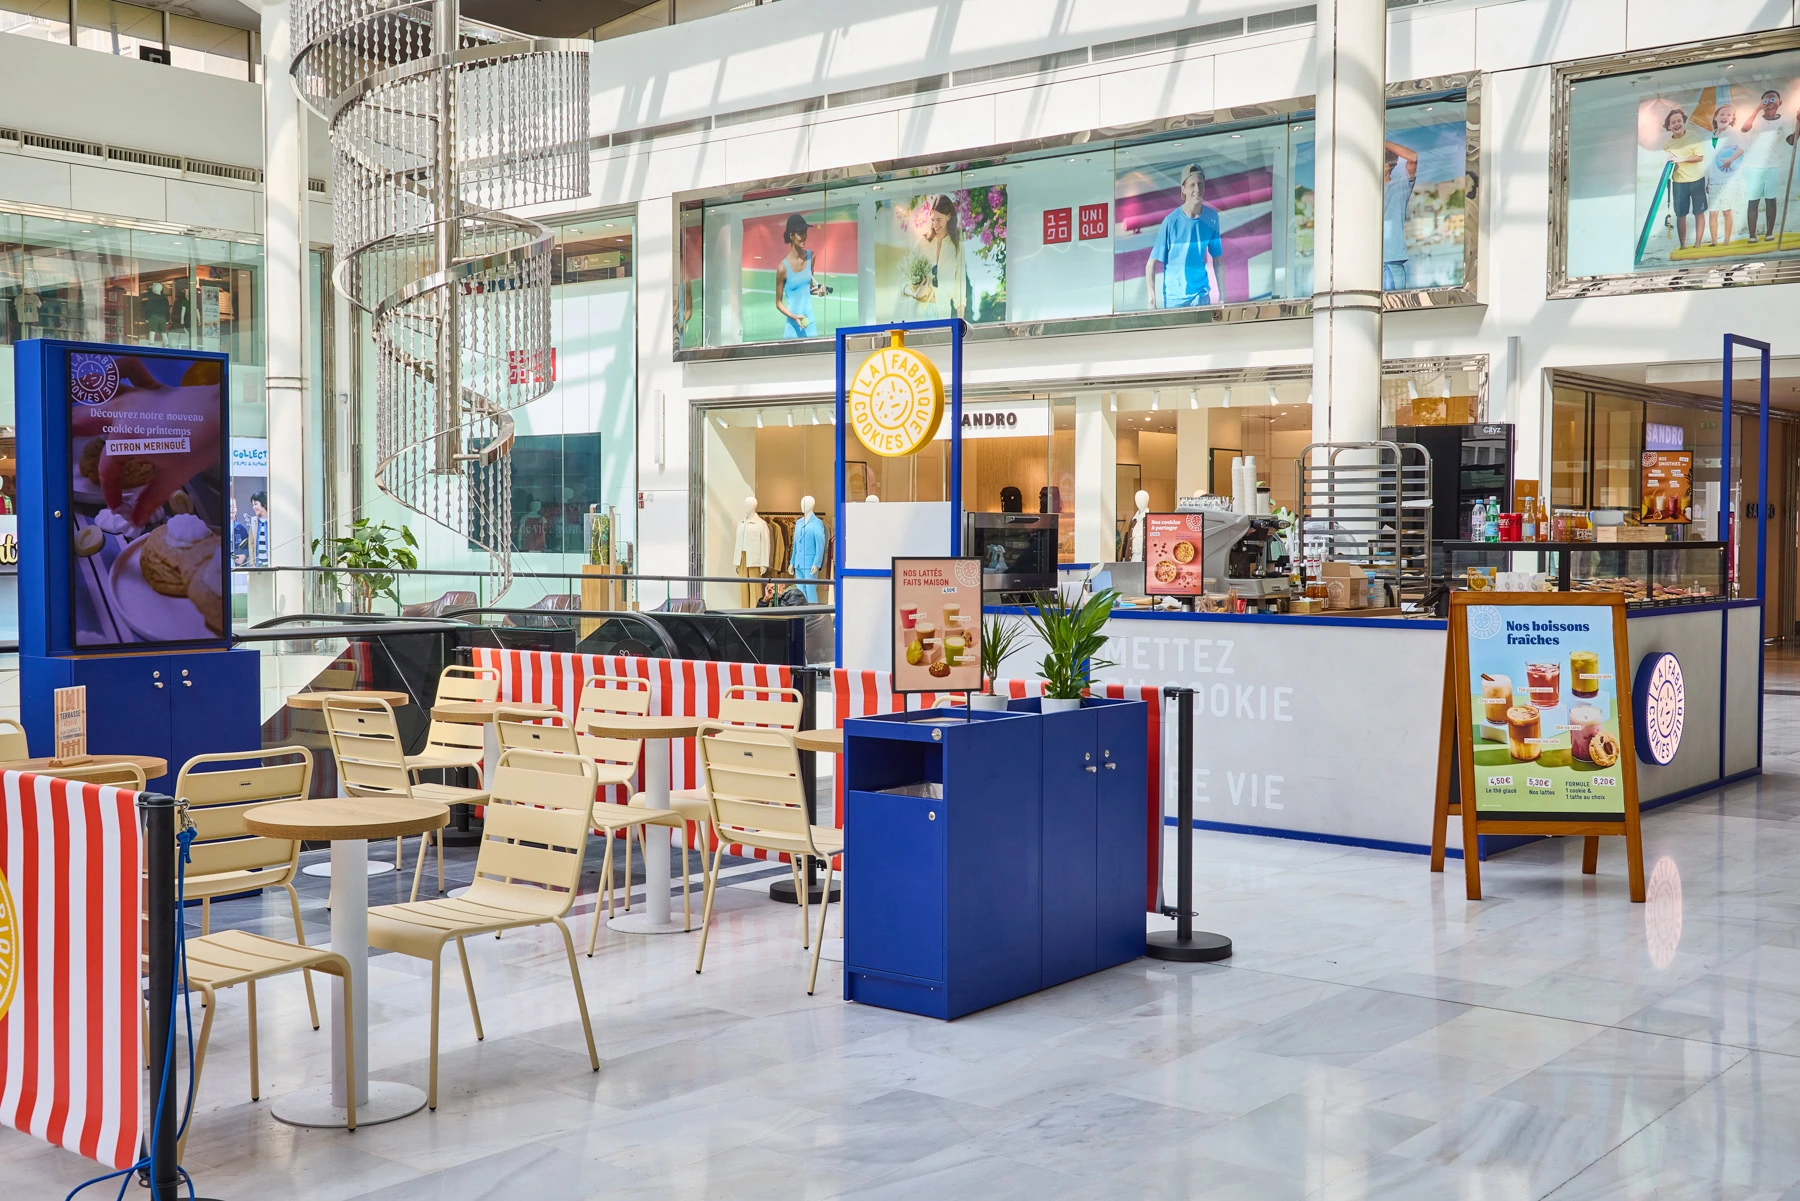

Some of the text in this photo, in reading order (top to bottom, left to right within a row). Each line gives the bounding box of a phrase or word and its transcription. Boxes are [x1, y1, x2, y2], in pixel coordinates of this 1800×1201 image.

[1082, 208, 1102, 221] UNI
[1082, 222, 1104, 237] QLO
[860, 353, 931, 435] LA FABRIQUE
[90, 407, 204, 422] Découvrez notre nouveau
[961, 412, 1018, 427] ANDRO
[102, 424, 192, 437] cookie de printemps
[854, 401, 904, 450] COOKIES
[1646, 424, 1684, 445] SANDRO
[110, 439, 186, 452] CITRON MERINGUÉ
[919, 568, 943, 577] LATTÉS
[1506, 620, 1590, 632] Nos boissons
[1507, 633, 1560, 645] fraîches
[1104, 637, 1235, 674] METTEZ
[1653, 659, 1683, 744] LA FABRIQUE
[1649, 705, 1670, 759] COOKIES
[1490, 776, 1511, 786] 4,50€
[1528, 778, 1550, 788] 5,30€
[1593, 777, 1615, 786] 8,20€
[1226, 770, 1284, 809] VIE
